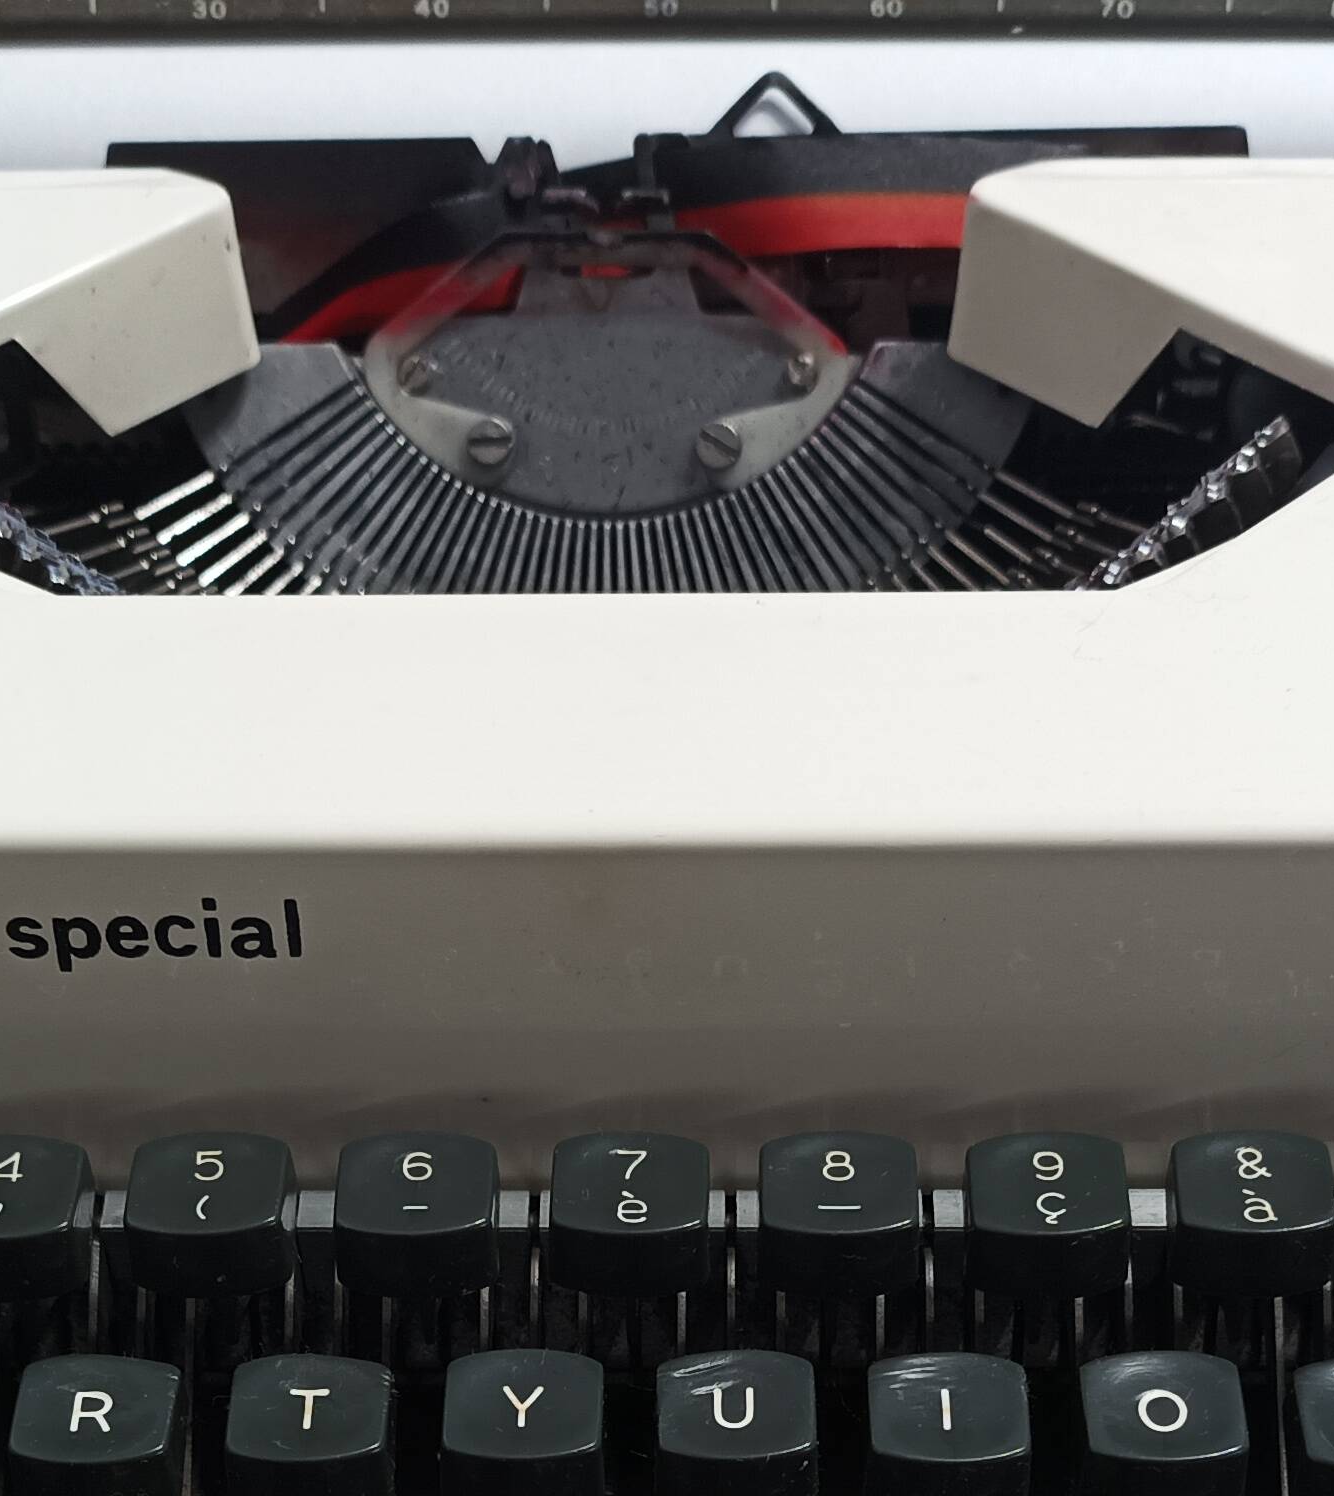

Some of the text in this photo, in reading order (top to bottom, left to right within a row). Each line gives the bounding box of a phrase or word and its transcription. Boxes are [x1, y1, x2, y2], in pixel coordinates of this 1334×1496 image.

[191, 0, 228, 21] 30
[412, 0, 451, 19] 40
[868, 0, 905, 19] 60
[1099, 0, 1136, 20] 70
[4, 896, 303, 974] special
[193, 1149, 225, 1182] 5
[401, 1150, 434, 1182] 6
[616, 1148, 648, 1181] 7
[821, 1149, 856, 1183] 8
[1031, 1150, 1065, 1182] 9
[1234, 1145, 1273, 1181] &
[615, 1189, 649, 1225] è
[1035, 1191, 1068, 1226] ç
[1240, 1187, 1279, 1224] à
[68, 1389, 115, 1434] R
[288, 1387, 331, 1431] T
[501, 1384, 545, 1429] Y
[711, 1384, 756, 1430] U
[939, 1387, 953, 1432] I
[1136, 1387, 1189, 1434] O
